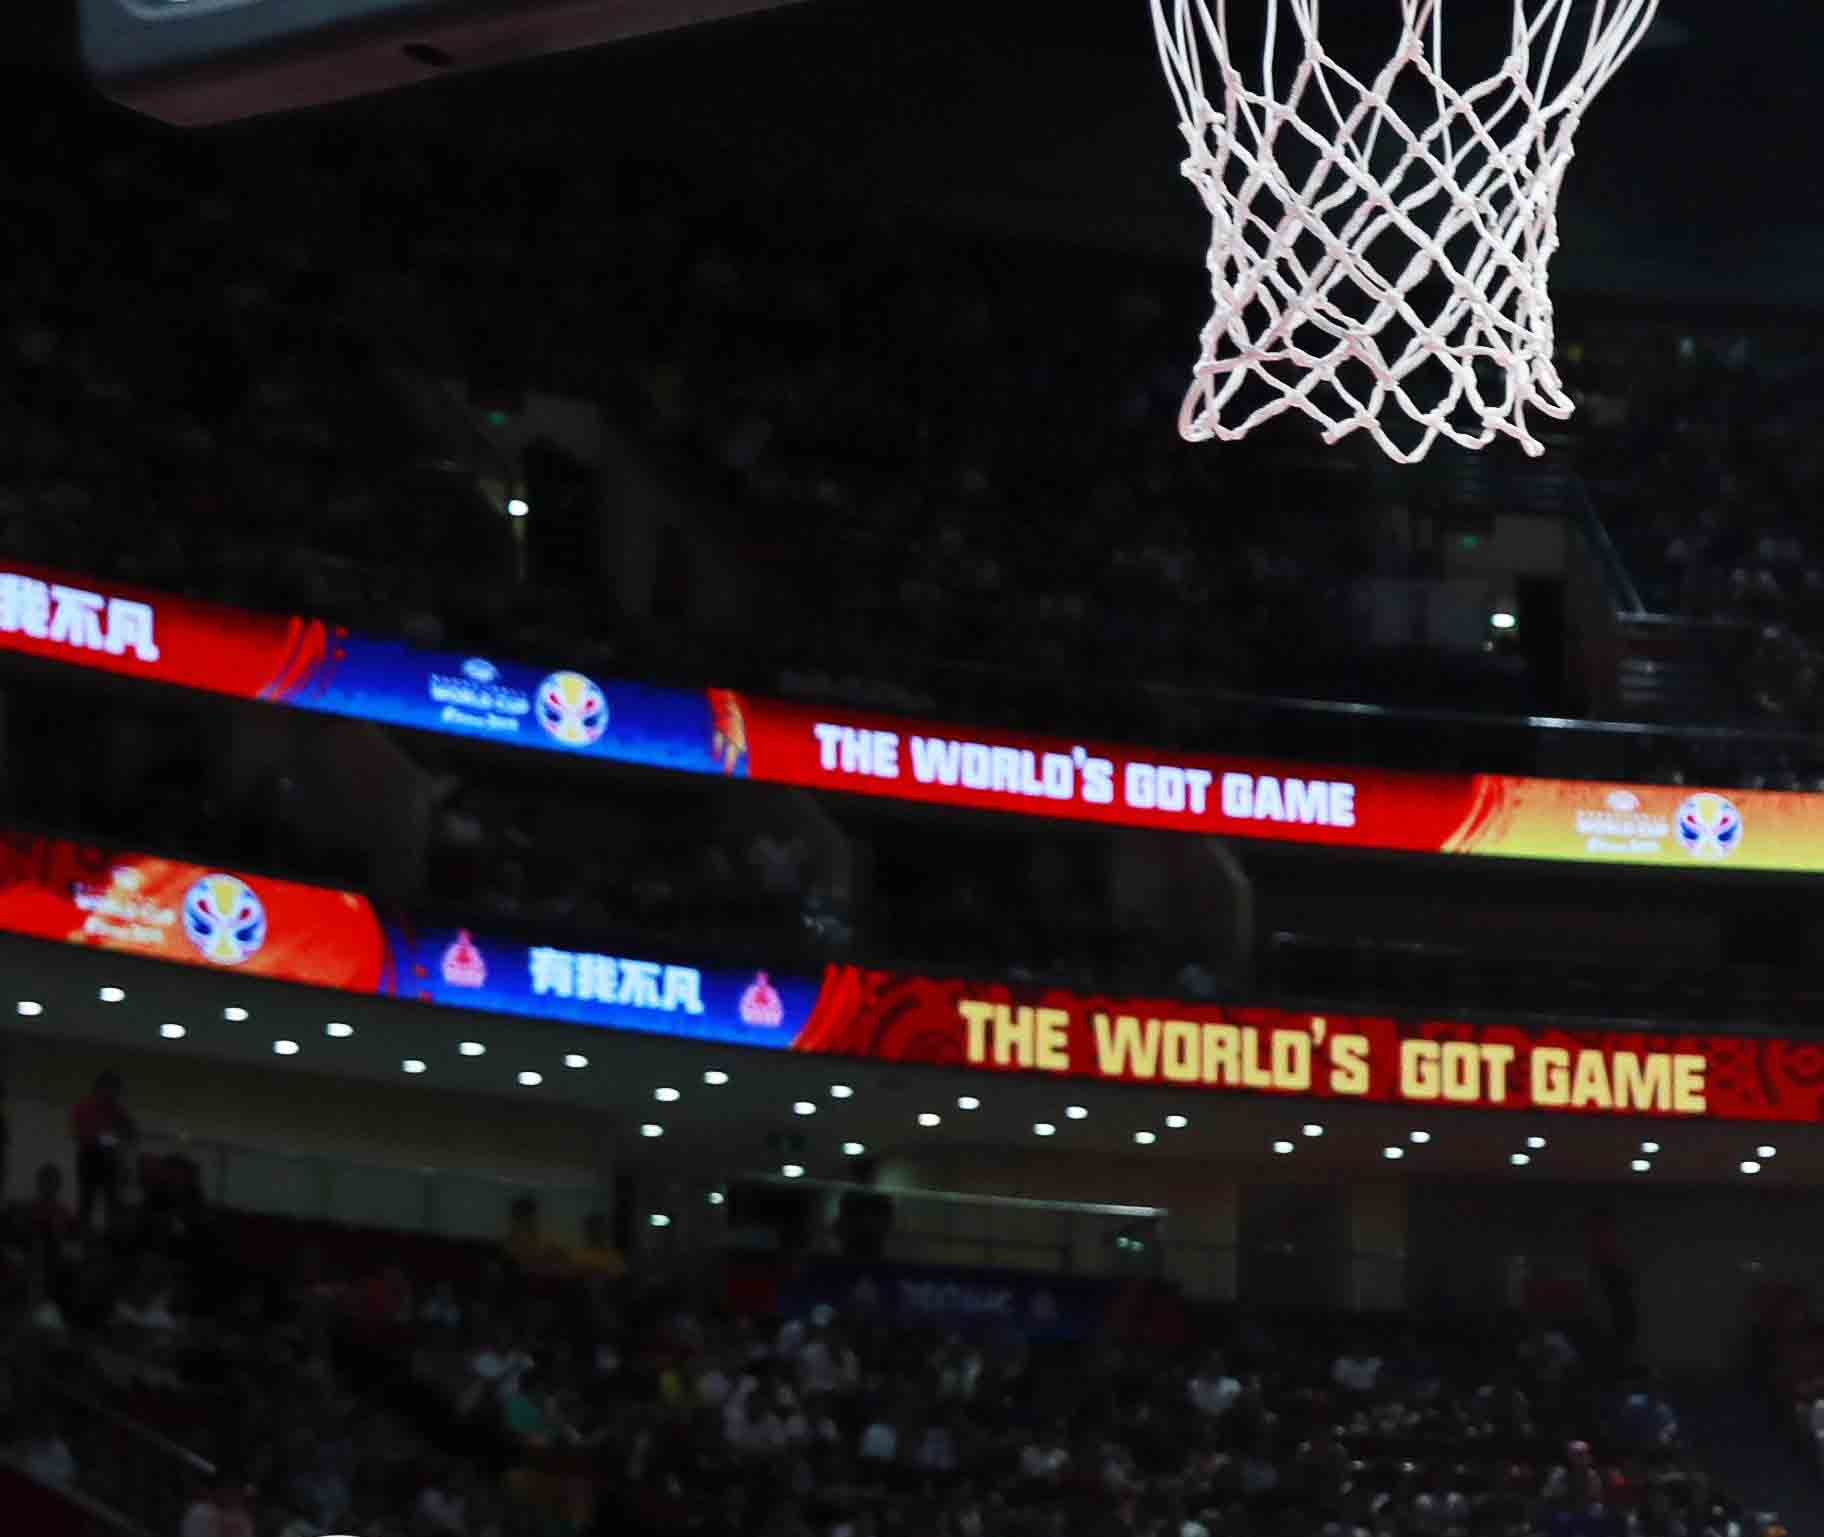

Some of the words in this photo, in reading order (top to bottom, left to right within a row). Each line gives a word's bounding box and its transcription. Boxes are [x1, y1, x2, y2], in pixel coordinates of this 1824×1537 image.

[814, 723, 899, 779] THE
[911, 735, 1114, 804] WORLD'S
[1124, 762, 1213, 815] GOT
[1221, 773, 1356, 828] GAME
[958, 1000, 1069, 1070] THE
[1093, 1013, 1370, 1096] WORLD'S
[1400, 1038, 1514, 1104] GOT
[1529, 1046, 1707, 1114] GAME
